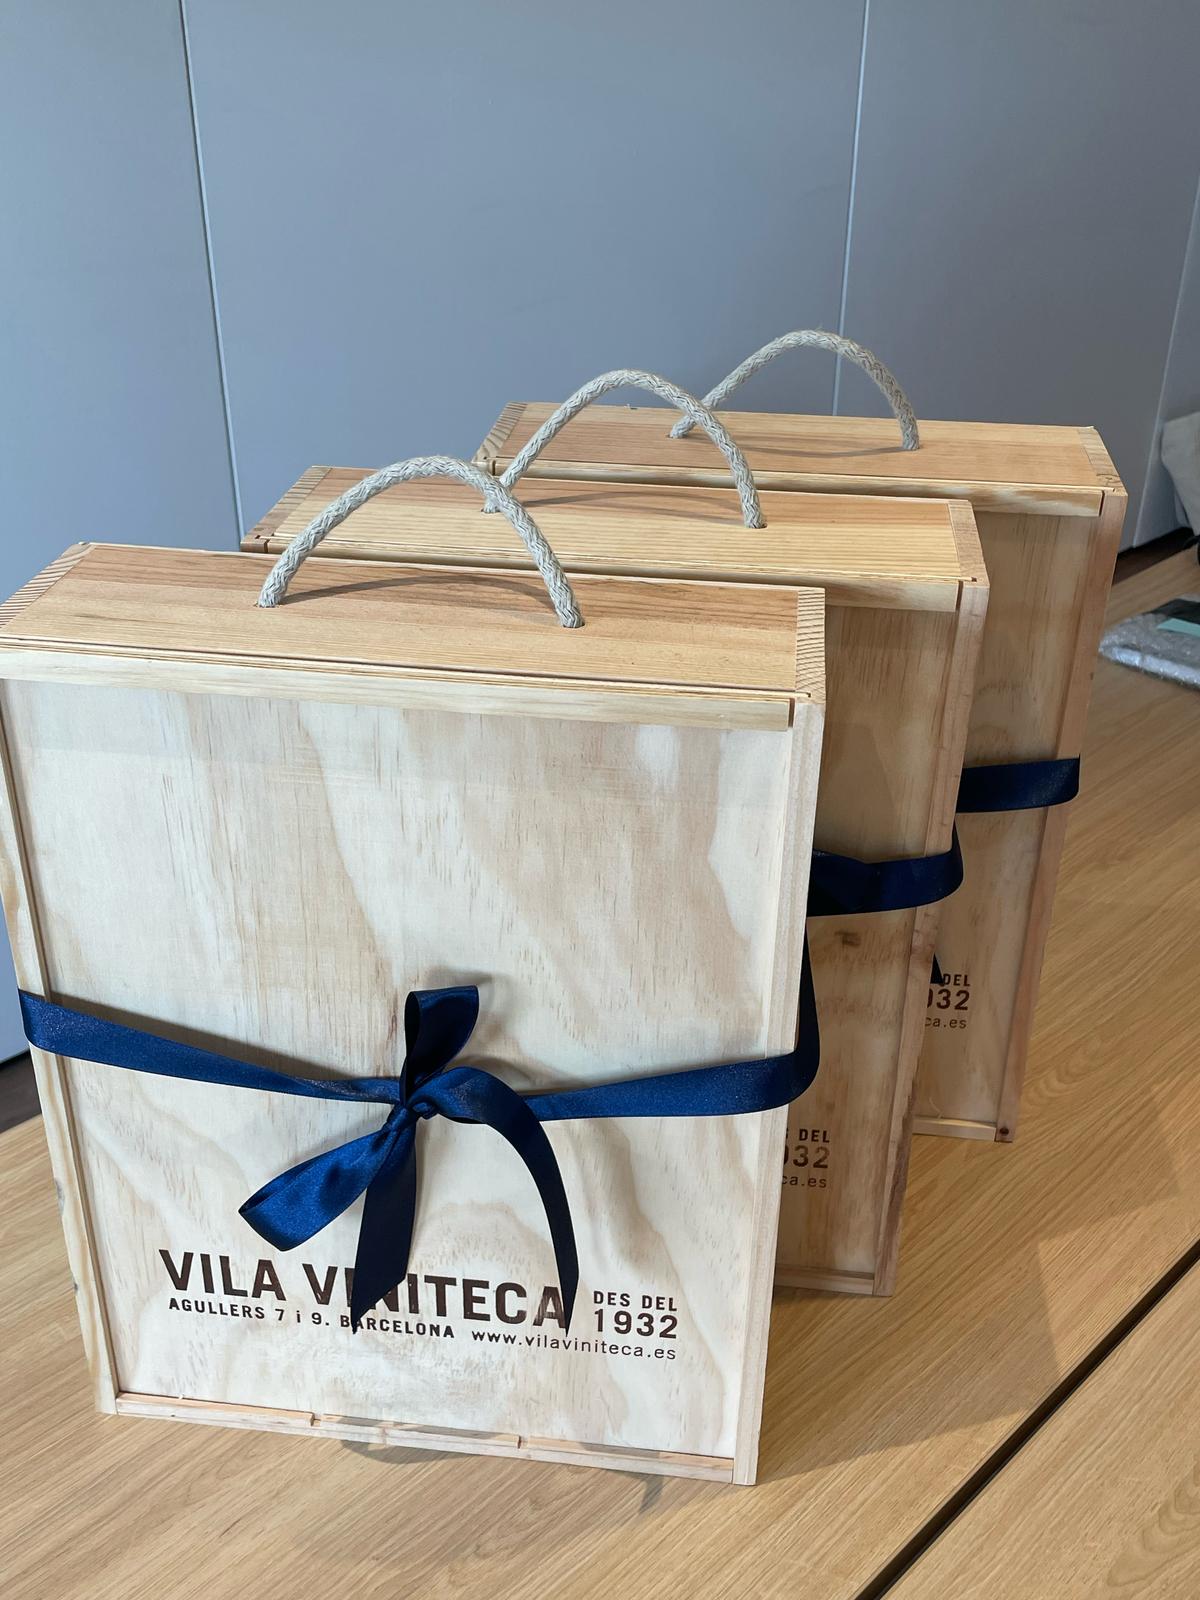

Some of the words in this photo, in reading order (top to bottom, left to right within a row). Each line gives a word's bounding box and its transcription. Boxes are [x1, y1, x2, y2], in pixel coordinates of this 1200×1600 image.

[943, 973, 970, 987] DEL
[799, 1128, 830, 1143] DEL
[158, 1249, 287, 1301] VILA
[168, 1297, 266, 1320] AGULLERS
[275, 1309, 285, 1321] 7
[311, 1312, 330, 1326] 9.
[593, 1290, 631, 1307] DES
[641, 1295, 678, 1312] DEL
[595, 1308, 679, 1339] 1932
[471, 1330, 677, 1360] www.vilaviniteca.es
